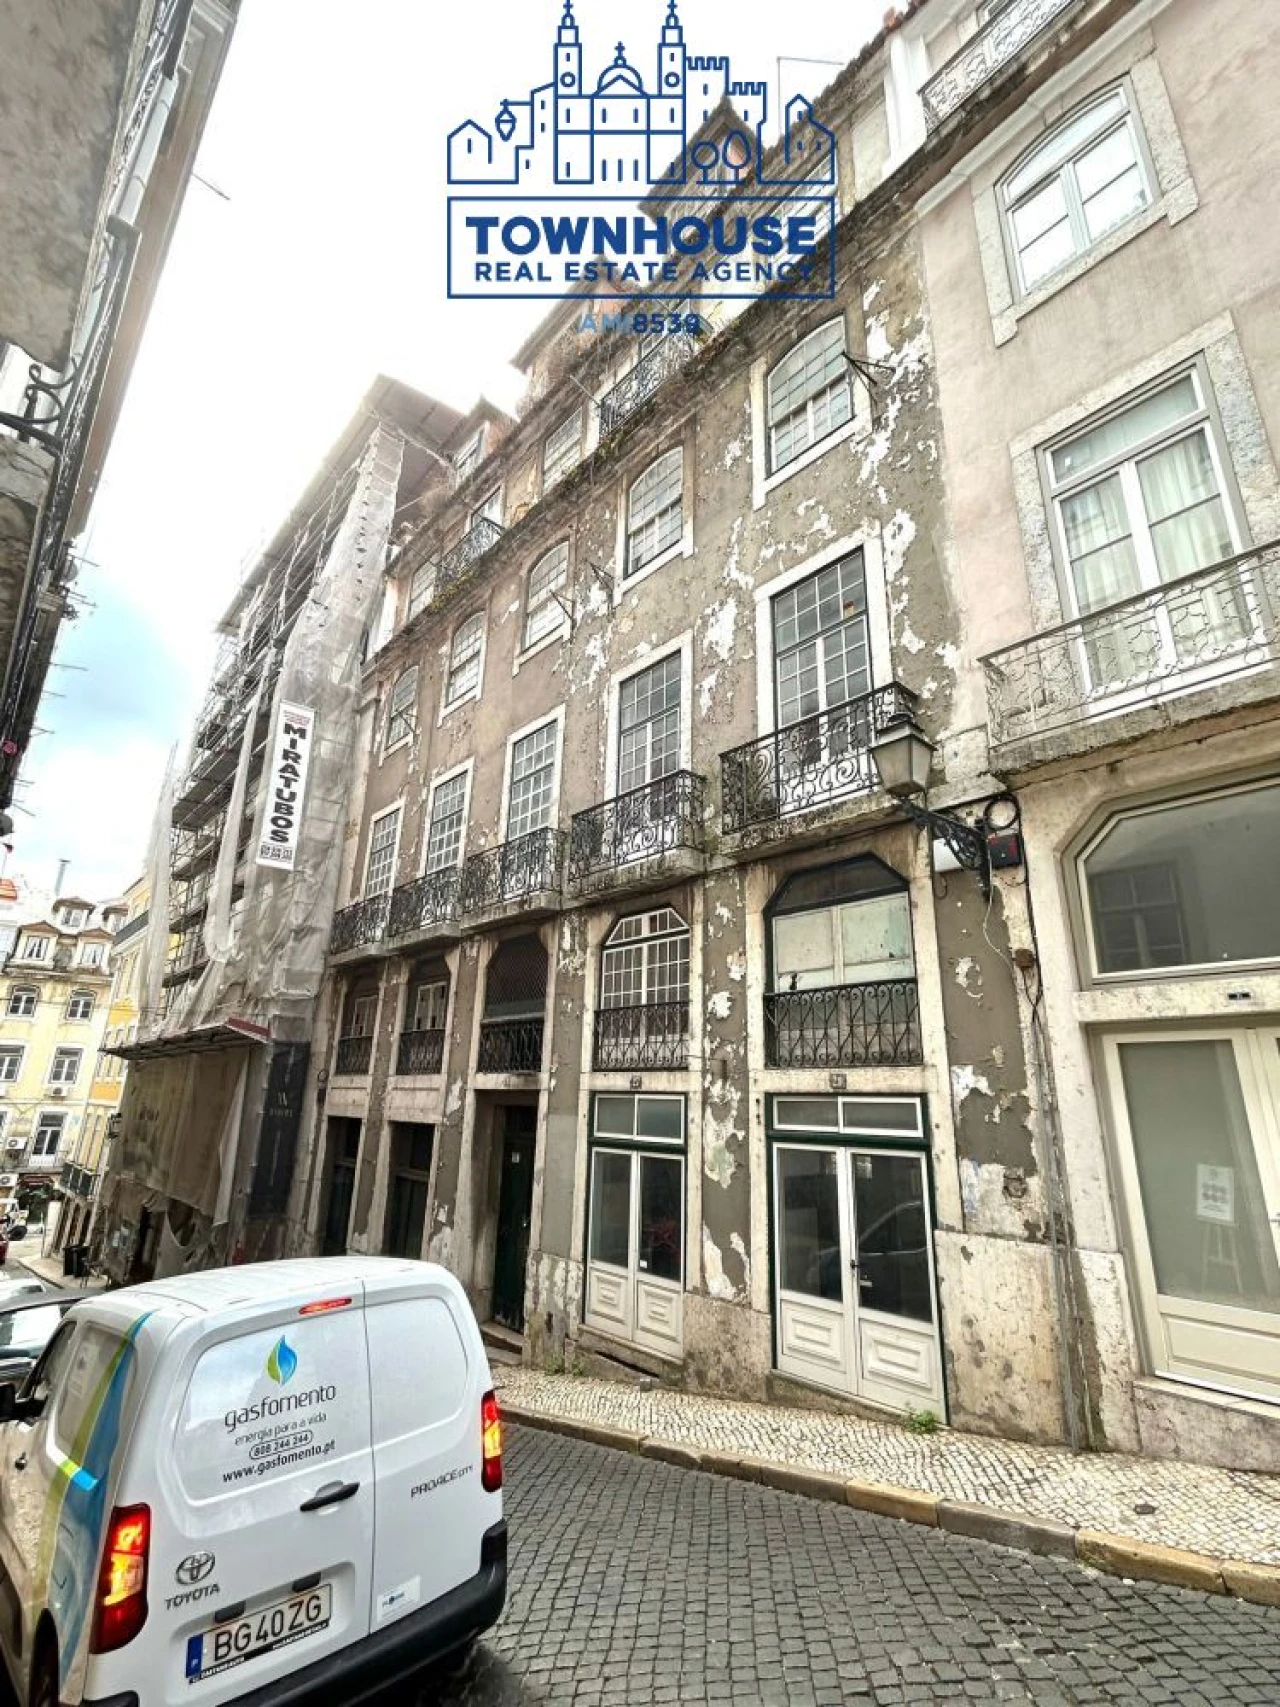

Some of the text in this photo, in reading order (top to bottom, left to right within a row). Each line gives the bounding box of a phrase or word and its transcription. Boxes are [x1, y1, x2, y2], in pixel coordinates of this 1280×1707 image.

[270, 723, 307, 843] MIRATUBOS
[224, 1385, 337, 1434] gasfomento
[235, 1411, 327, 1446] energia para a vida
[222, 1439, 336, 1483] www.gasfomento.pt
[410, 1467, 458, 1498] PROACE
[164, 1583, 221, 1611] TOYOTA
